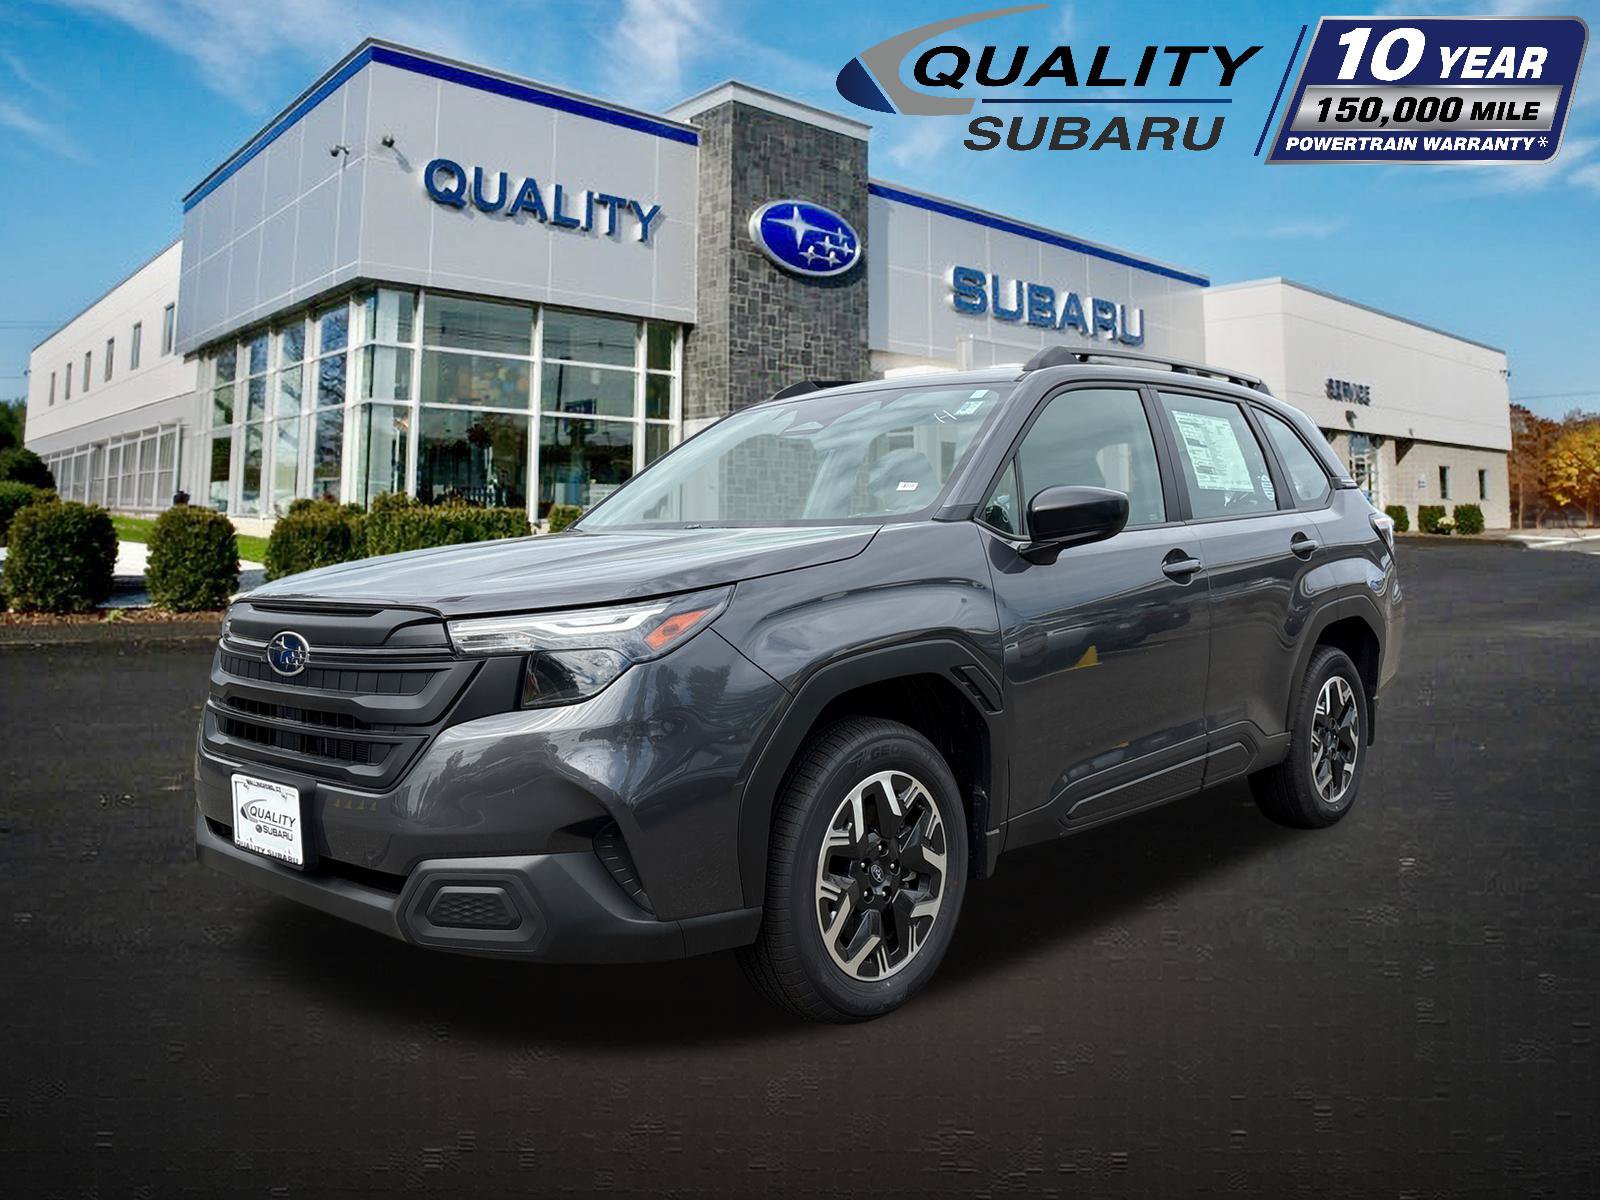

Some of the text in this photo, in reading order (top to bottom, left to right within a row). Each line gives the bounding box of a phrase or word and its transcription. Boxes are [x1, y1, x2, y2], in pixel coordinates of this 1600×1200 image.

[424, 158, 661, 243] QUALITY
[950, 265, 1145, 347] SUBARU
[250, 806, 296, 827] QUALITY
[262, 825, 293, 841] SUBARU
